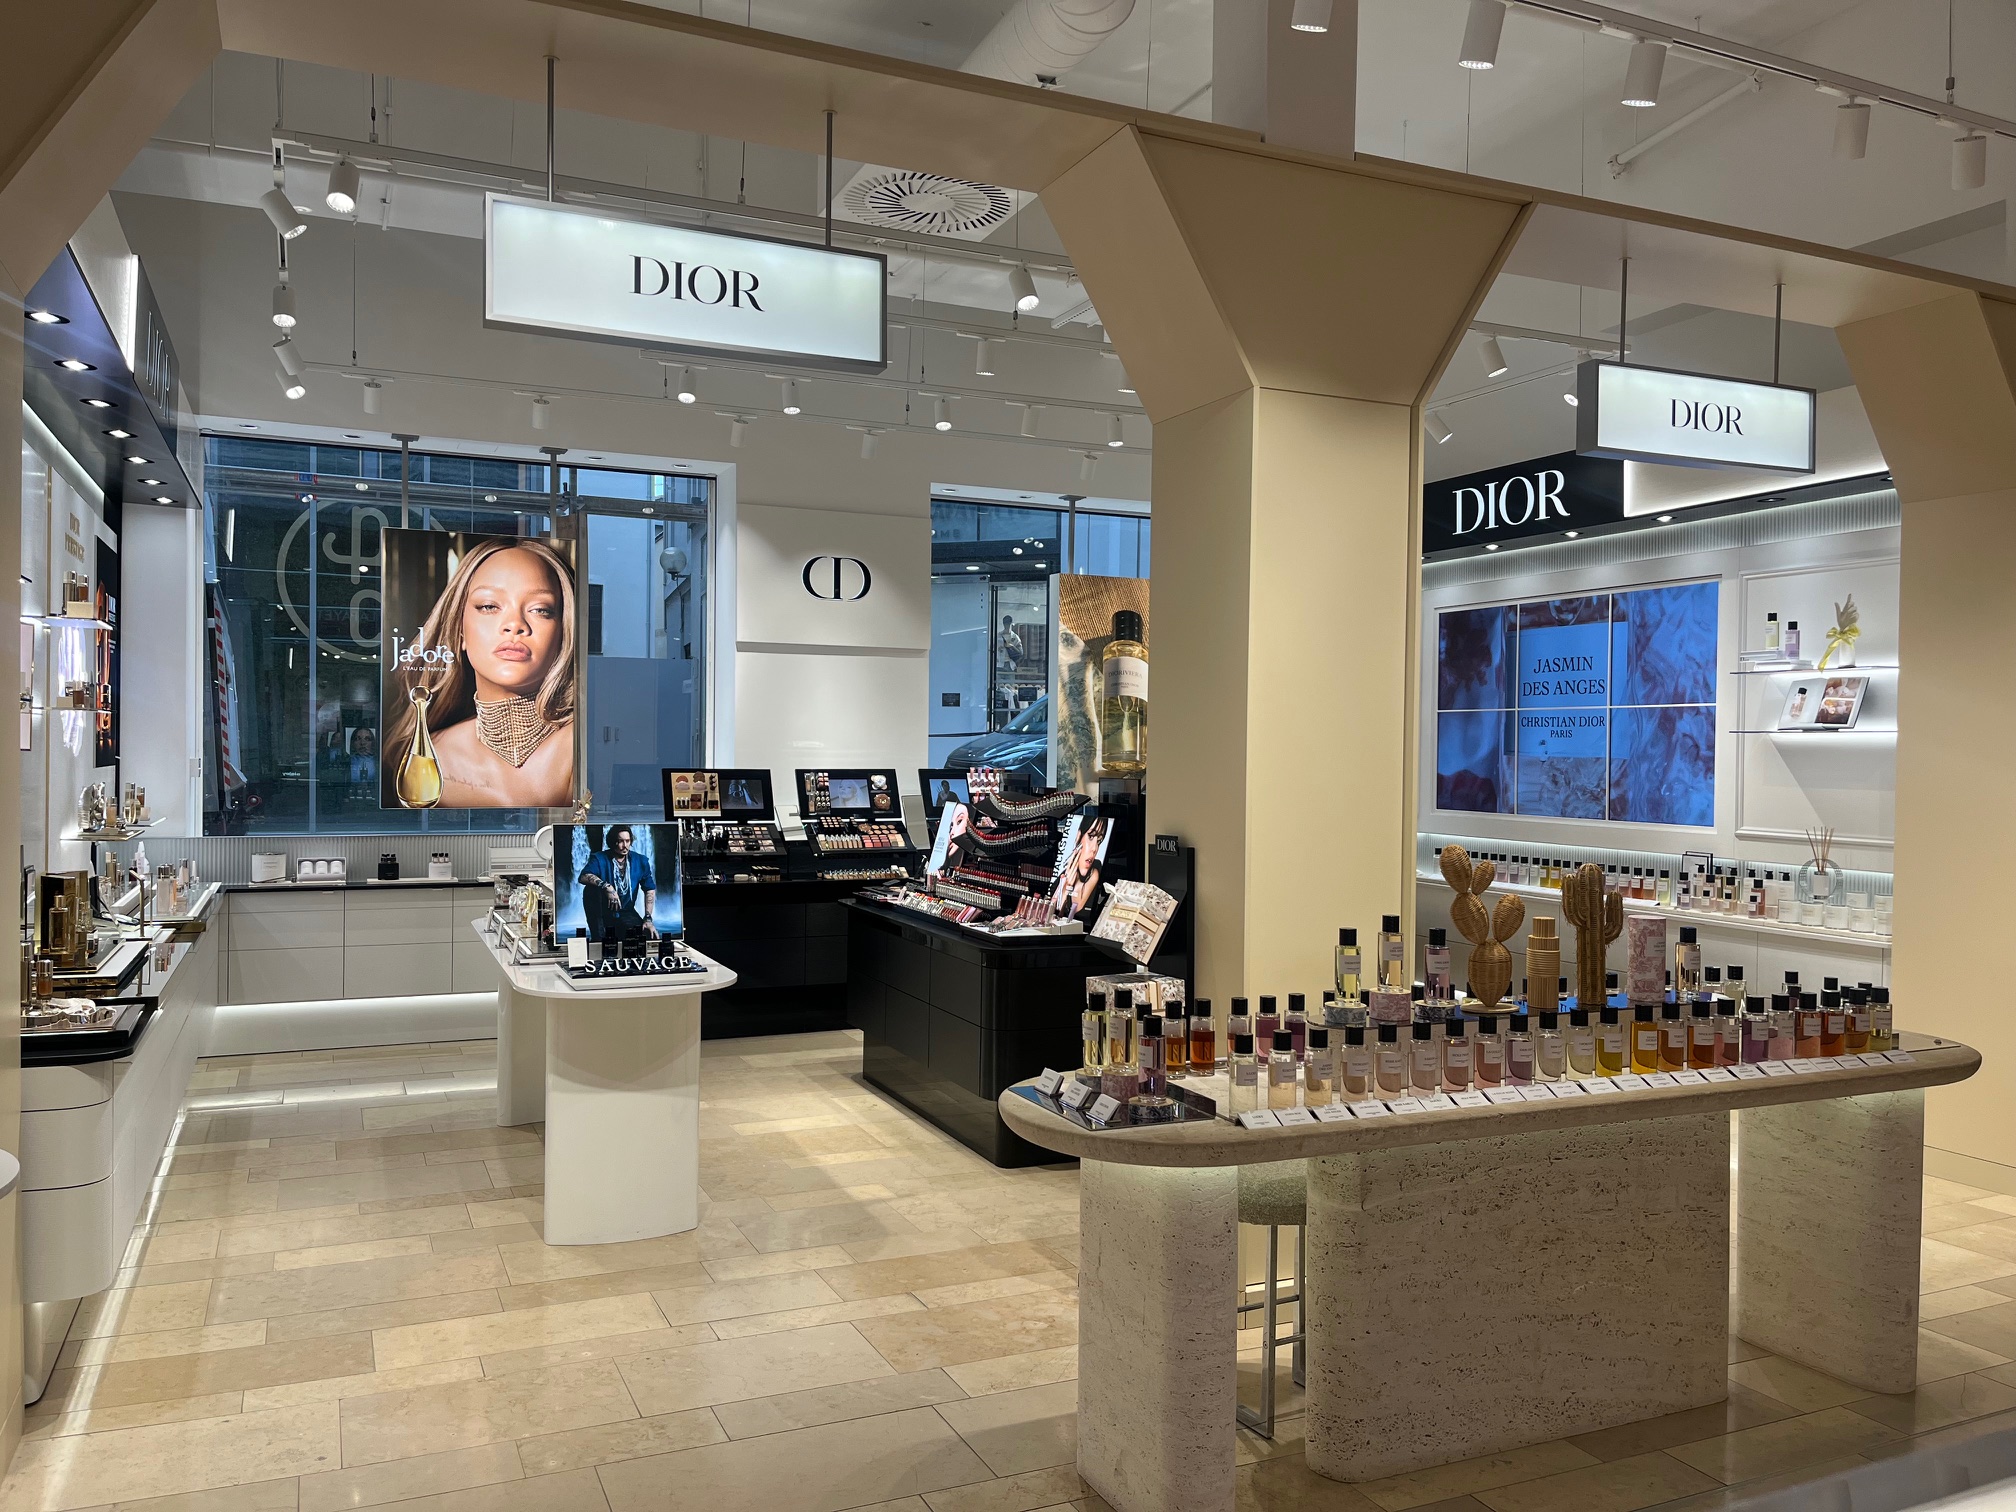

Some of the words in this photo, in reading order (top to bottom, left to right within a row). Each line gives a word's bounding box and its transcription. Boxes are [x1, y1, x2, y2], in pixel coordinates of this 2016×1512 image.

[629, 254, 766, 313] DIOR
[146, 311, 172, 428] DIOR
[1671, 398, 1744, 436] DIOR
[1452, 469, 1571, 536] DIOR
[1533, 656, 1594, 674] JASMIN
[1522, 681, 1550, 697] DES
[1553, 678, 1606, 695] ANGES
[1521, 716, 1576, 728] CHRISTIAN
[1578, 716, 1606, 728] DIOR
[1550, 730, 1573, 739] PARIS
[1052, 813, 1075, 878] BACKSTAGE
[1157, 838, 1177, 852] DIOR
[585, 956, 692, 973] SAUVAGE
